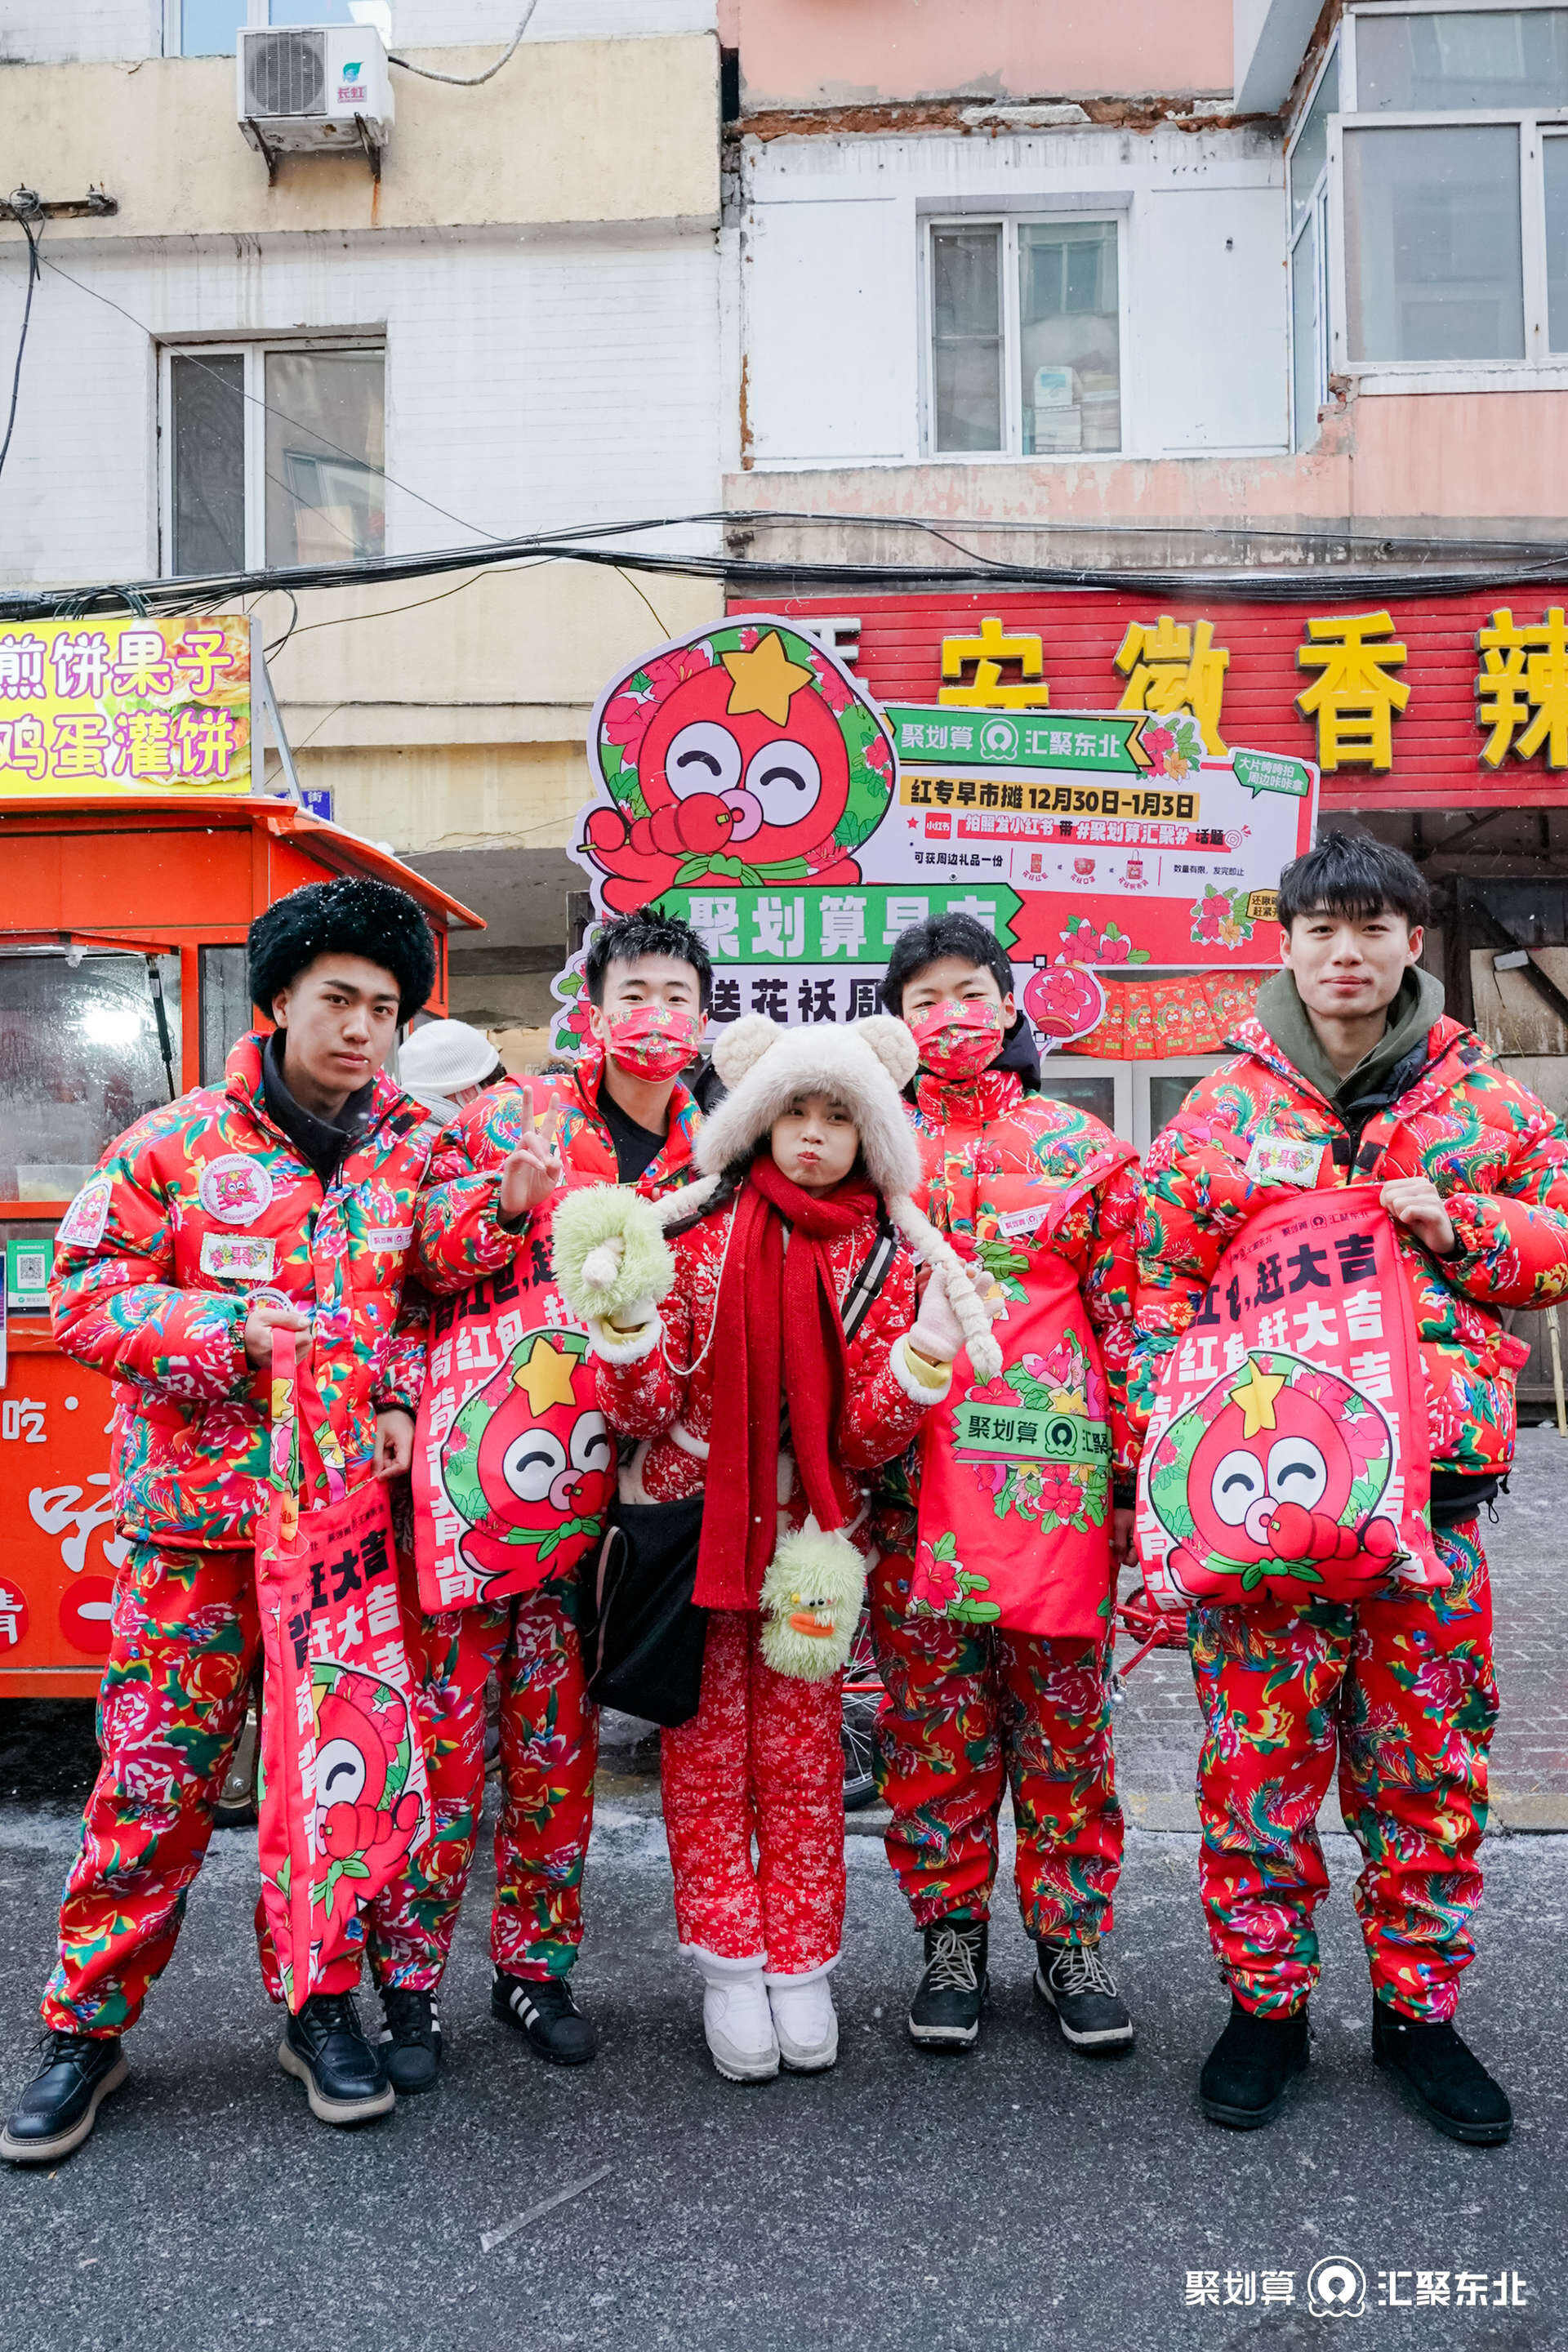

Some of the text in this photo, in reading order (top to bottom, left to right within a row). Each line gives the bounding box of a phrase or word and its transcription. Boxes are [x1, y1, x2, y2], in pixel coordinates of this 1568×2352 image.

[337, 87, 364, 99] 长虹
[0, 630, 234, 699] 煎饼果子
[0, 707, 236, 780] 鸡蛋灌饼
[901, 723, 1120, 759] 聚划算 汇聚东北
[911, 778, 1194, 819] 红专早市摊 12月30日-1月3日
[926, 820, 951, 832] 小红书
[964, 813, 1054, 836] 拍照发小红书
[1196, 828, 1224, 845] 话题
[915, 851, 1004, 867] 可获周边礼品一份
[2, 1397, 47, 1444] 吃
[968, 1415, 1039, 1445] 聚划算
